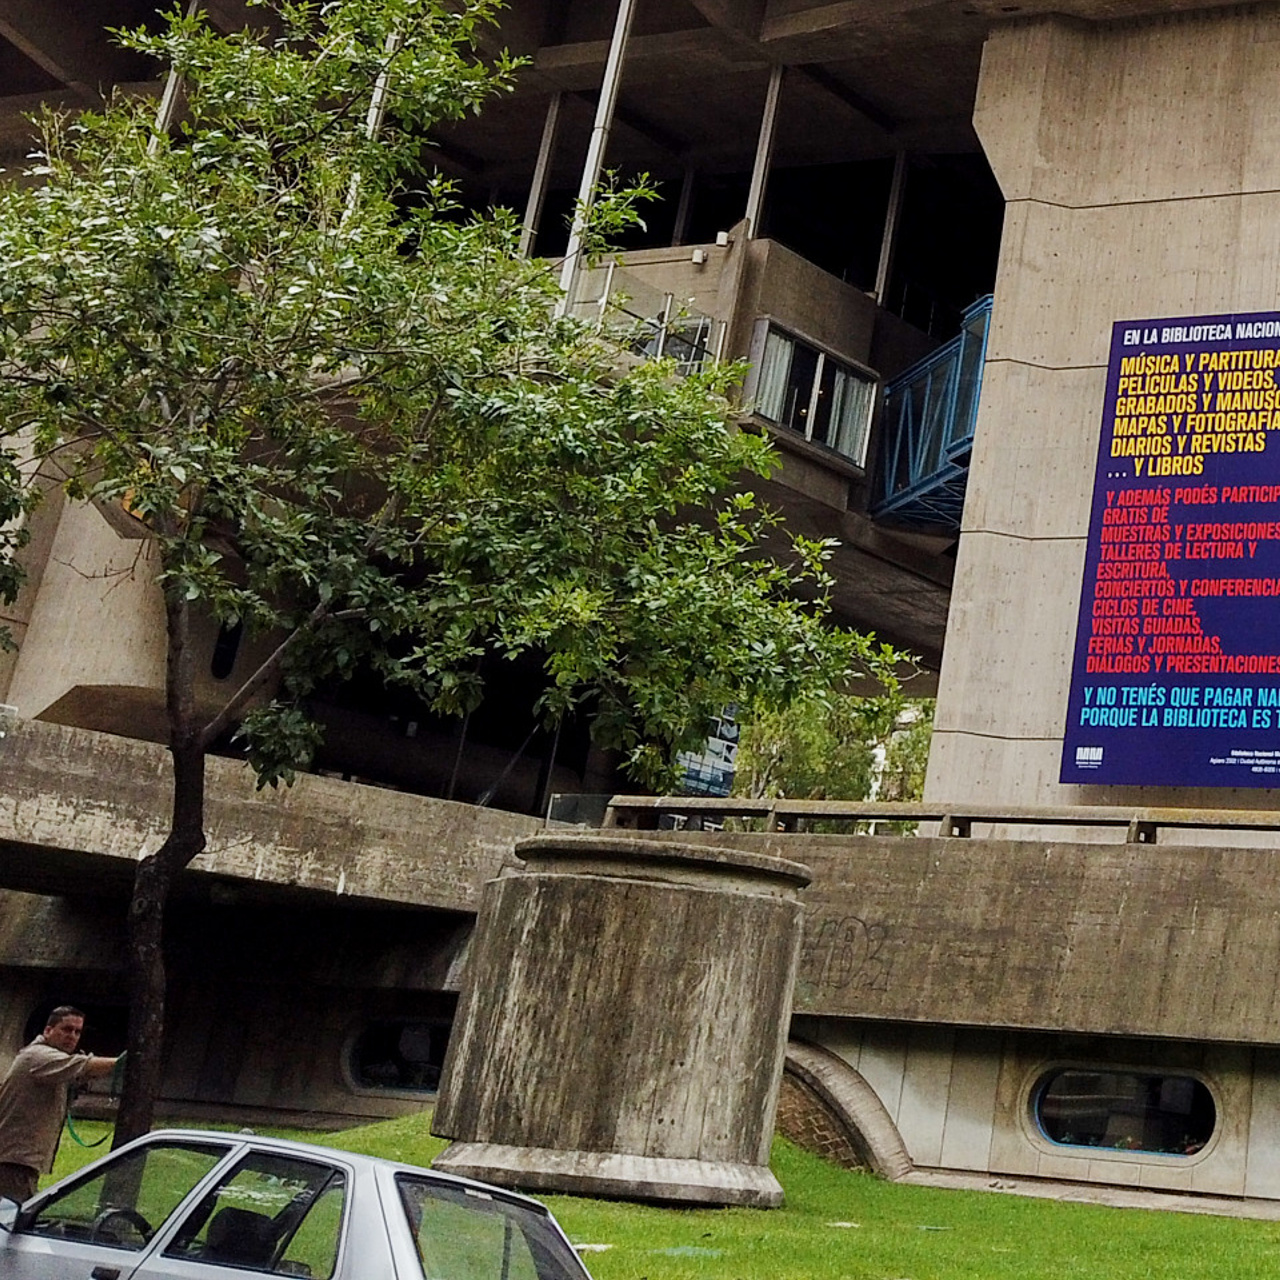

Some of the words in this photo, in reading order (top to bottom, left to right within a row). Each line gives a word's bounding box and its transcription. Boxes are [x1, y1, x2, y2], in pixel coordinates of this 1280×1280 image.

[1123, 329, 1141, 346] EN
[1143, 327, 1158, 344] LA
[1161, 323, 1232, 343] BIBLIOTECA
[1120, 352, 1180, 376] MÚSICA
[1185, 353, 1196, 372] Y
[1118, 372, 1199, 396] PELÍCULAS
[1203, 372, 1214, 392] Y
[1217, 369, 1278, 391] VIDEOS,
[1116, 393, 1197, 416] GRABADOS
[1202, 393, 1213, 412] Y
[1113, 414, 1168, 436] MAPAS
[1172, 414, 1183, 434] Y
[1110, 435, 1172, 457] DIARIOS
[1177, 435, 1188, 454] Y
[1190, 431, 1266, 453] REVISTAS
[1134, 457, 1145, 477] Y
[1147, 454, 1204, 476] LIBROS
[1106, 490, 1116, 507] Y
[1117, 484, 1172, 506] ADEMÁS
[1174, 483, 1218, 505] PODÉS
[1103, 506, 1149, 525] GRATIS
[1151, 506, 1170, 523] DE
[1101, 524, 1172, 543] MUESTRAS
[1175, 524, 1184, 541] Y
[1101, 542, 1161, 561] TALLERES
[1164, 542, 1183, 560] DE
[1185, 541, 1244, 559] LECTURA
[1248, 541, 1257, 559] Y
[1096, 561, 1171, 580] ESCRITURA,
[1094, 579, 1176, 598] CONCIERTOS
[1179, 579, 1188, 597] Y
[1092, 598, 1139, 617] CICLOS
[1141, 598, 1160, 616] DE
[1162, 598, 1197, 618] CINE,
[1091, 617, 1140, 636] VISITAS
[1142, 617, 1204, 638] GUIADAS,
[1088, 635, 1134, 655] FERIAS
[1137, 636, 1146, 654] Y
[1148, 635, 1223, 657] JORNADAS,
[1086, 652, 1151, 673] DIÁLOGOS
[1154, 655, 1163, 673] Y
[1084, 686, 1093, 706] Y
[1096, 686, 1117, 706] NO
[1121, 682, 1166, 707] TENÉS
[1170, 687, 1200, 708] QUE
[1203, 686, 1254, 707] PAGAR
[1080, 707, 1138, 729] PORQUE
[1141, 707, 1158, 727] LA
[1162, 707, 1248, 728] BIBLIOTECA
[1251, 709, 1272, 729] ES
